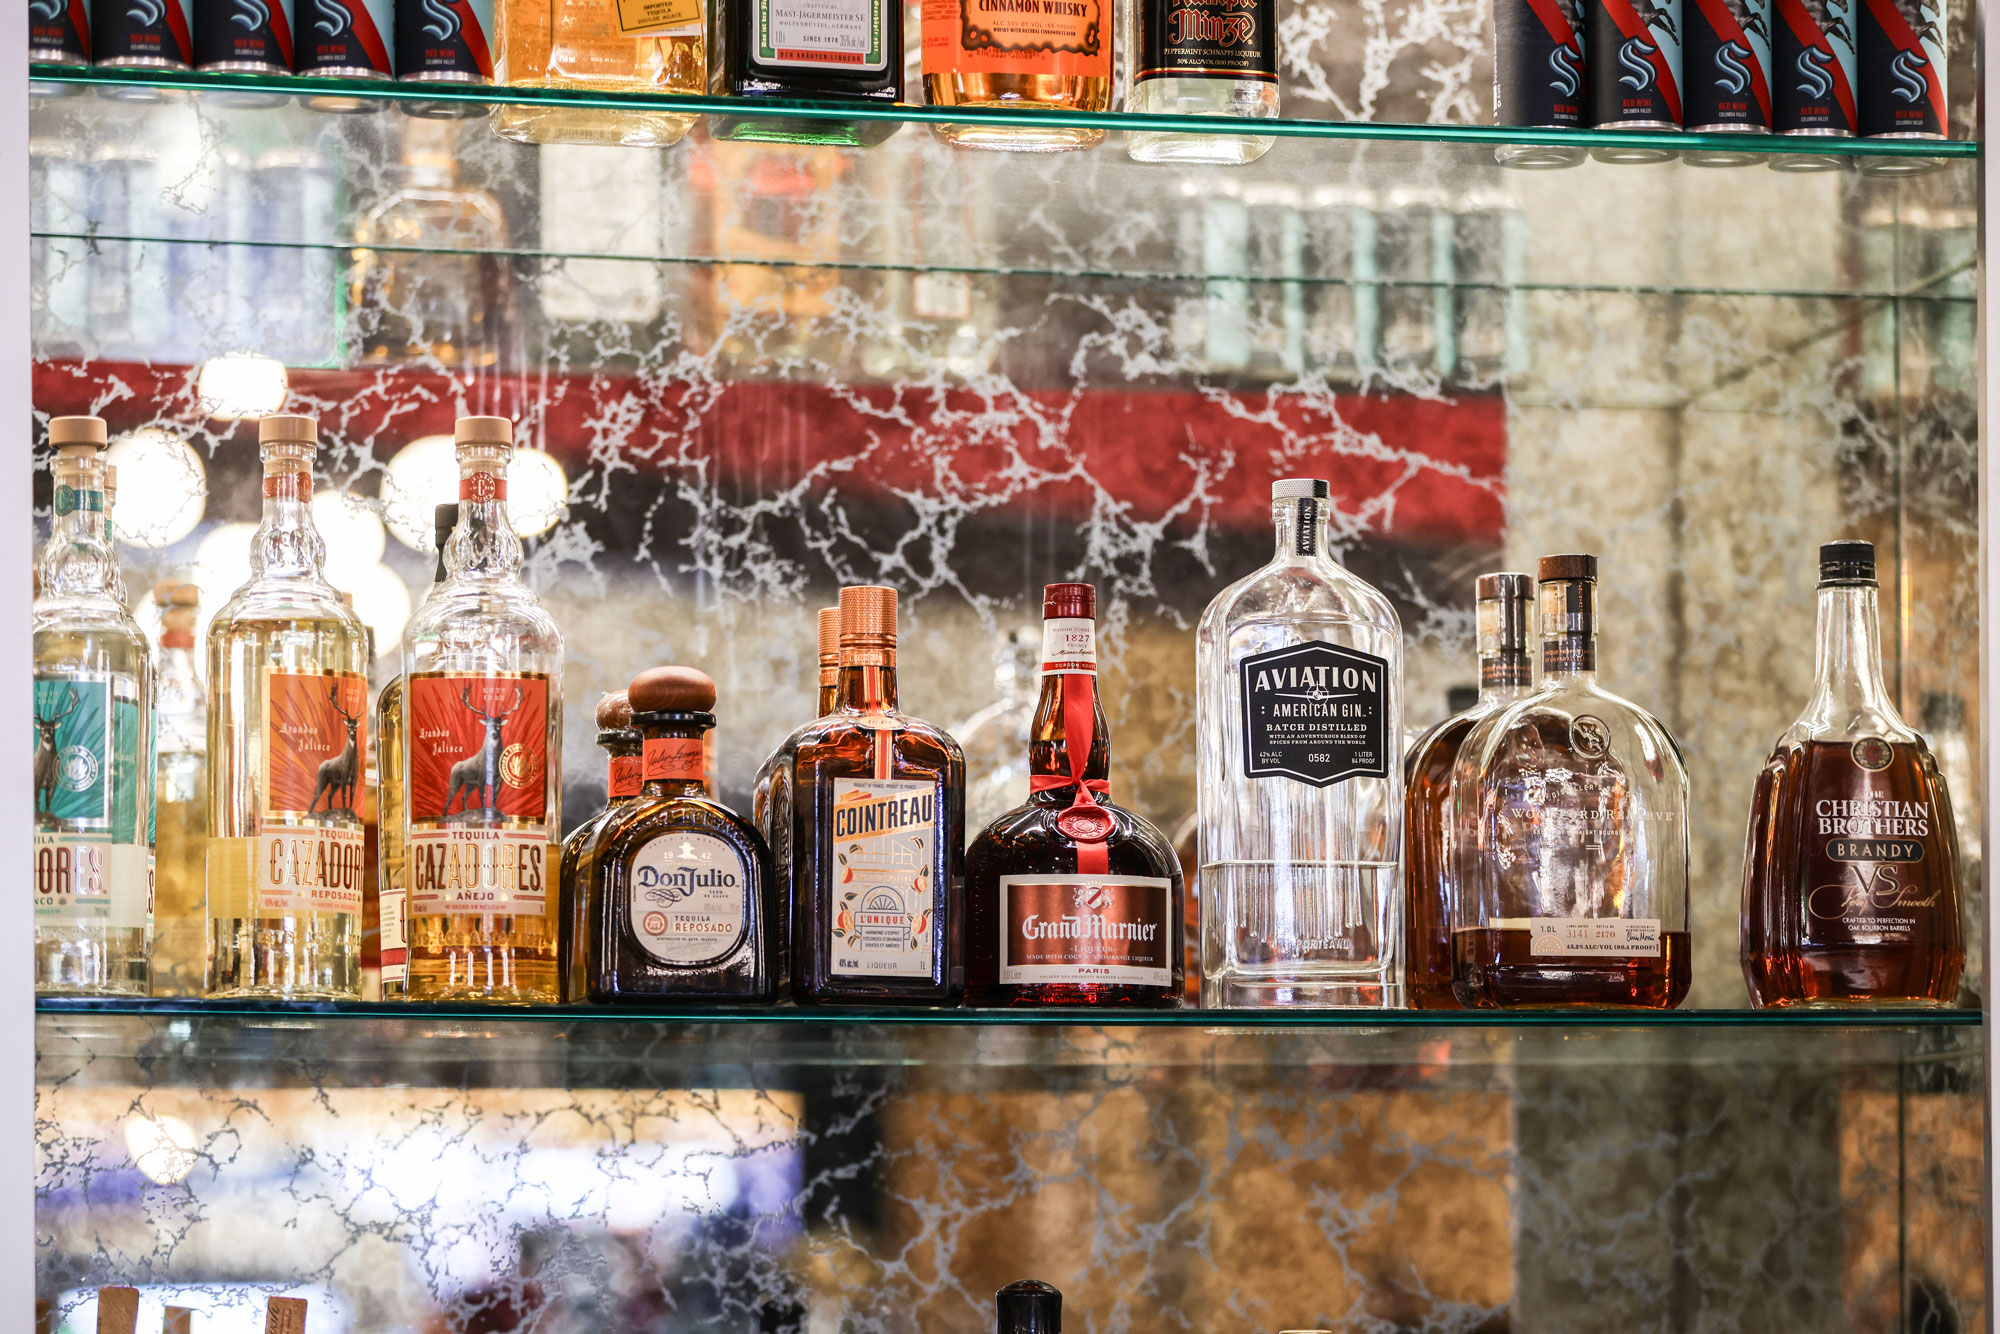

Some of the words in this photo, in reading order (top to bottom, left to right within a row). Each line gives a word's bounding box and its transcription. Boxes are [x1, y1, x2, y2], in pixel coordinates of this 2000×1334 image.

[644, 2, 672, 10] IMPORTED
[979, 0, 1040, 12] CINNAMON
[1042, 0, 1088, 17] WHISKY
[646, 8, 672, 16] TEQUILA
[855, 12, 866, 22] SE
[1169, 8, 1256, 47] Minze
[425, 49, 438, 58] RED
[439, 49, 456, 58] WINE
[1203, 48, 1234, 56] SCHNAPPS
[1234, 50, 1260, 58] LIQUEUR
[1622, 99, 1635, 107] RED
[1636, 98, 1652, 107] WINE
[1719, 102, 1730, 110] RED
[1732, 102, 1748, 110] WINE
[1554, 104, 1565, 112] RED
[1566, 105, 1578, 114] WINE
[1800, 107, 1812, 115] RED
[1814, 106, 1829, 115] WINE
[1896, 110, 1908, 119] RED
[1908, 110, 1924, 118] WINE
[1302, 506, 1312, 552] AVIATION
[1066, 634, 1090, 642] 1827
[1254, 666, 1376, 692] AVIATION
[1274, 704, 1337, 717] AMERICAN
[1342, 704, 1362, 717] GIN
[1266, 724, 1305, 732] BATCH
[1308, 724, 1367, 732] DISTILLED
[298, 738, 331, 752] Jalisco
[432, 741, 464, 756] Jalisco
[1308, 754, 1331, 762] 0582
[1864, 790, 1884, 799] THE
[1816, 800, 1928, 819] CHRISTIAN
[836, 794, 932, 837] COINTREAU
[1818, 818, 1929, 837] BROTHERS
[319, 829, 355, 840] TEQUILA
[452, 832, 500, 841] TEQUILA
[1838, 843, 1913, 858] BRANDY
[270, 838, 364, 892] CAZADOR
[416, 843, 541, 891] CAZADORES
[638, 866, 687, 888] Don
[678, 866, 736, 897] Julio
[1850, 865, 1900, 896] VS
[311, 890, 357, 902] REPOSADO
[457, 890, 494, 900] AÑEJO
[1809, 884, 1869, 920] Very
[1871, 885, 1942, 908] Smooth
[860, 915, 904, 925] L'UNIQUE
[675, 923, 733, 933] REPOSADO
[1022, 914, 1081, 940] Grand
[1081, 914, 1156, 942] Marnier
[1567, 930, 1588, 938] 3141
